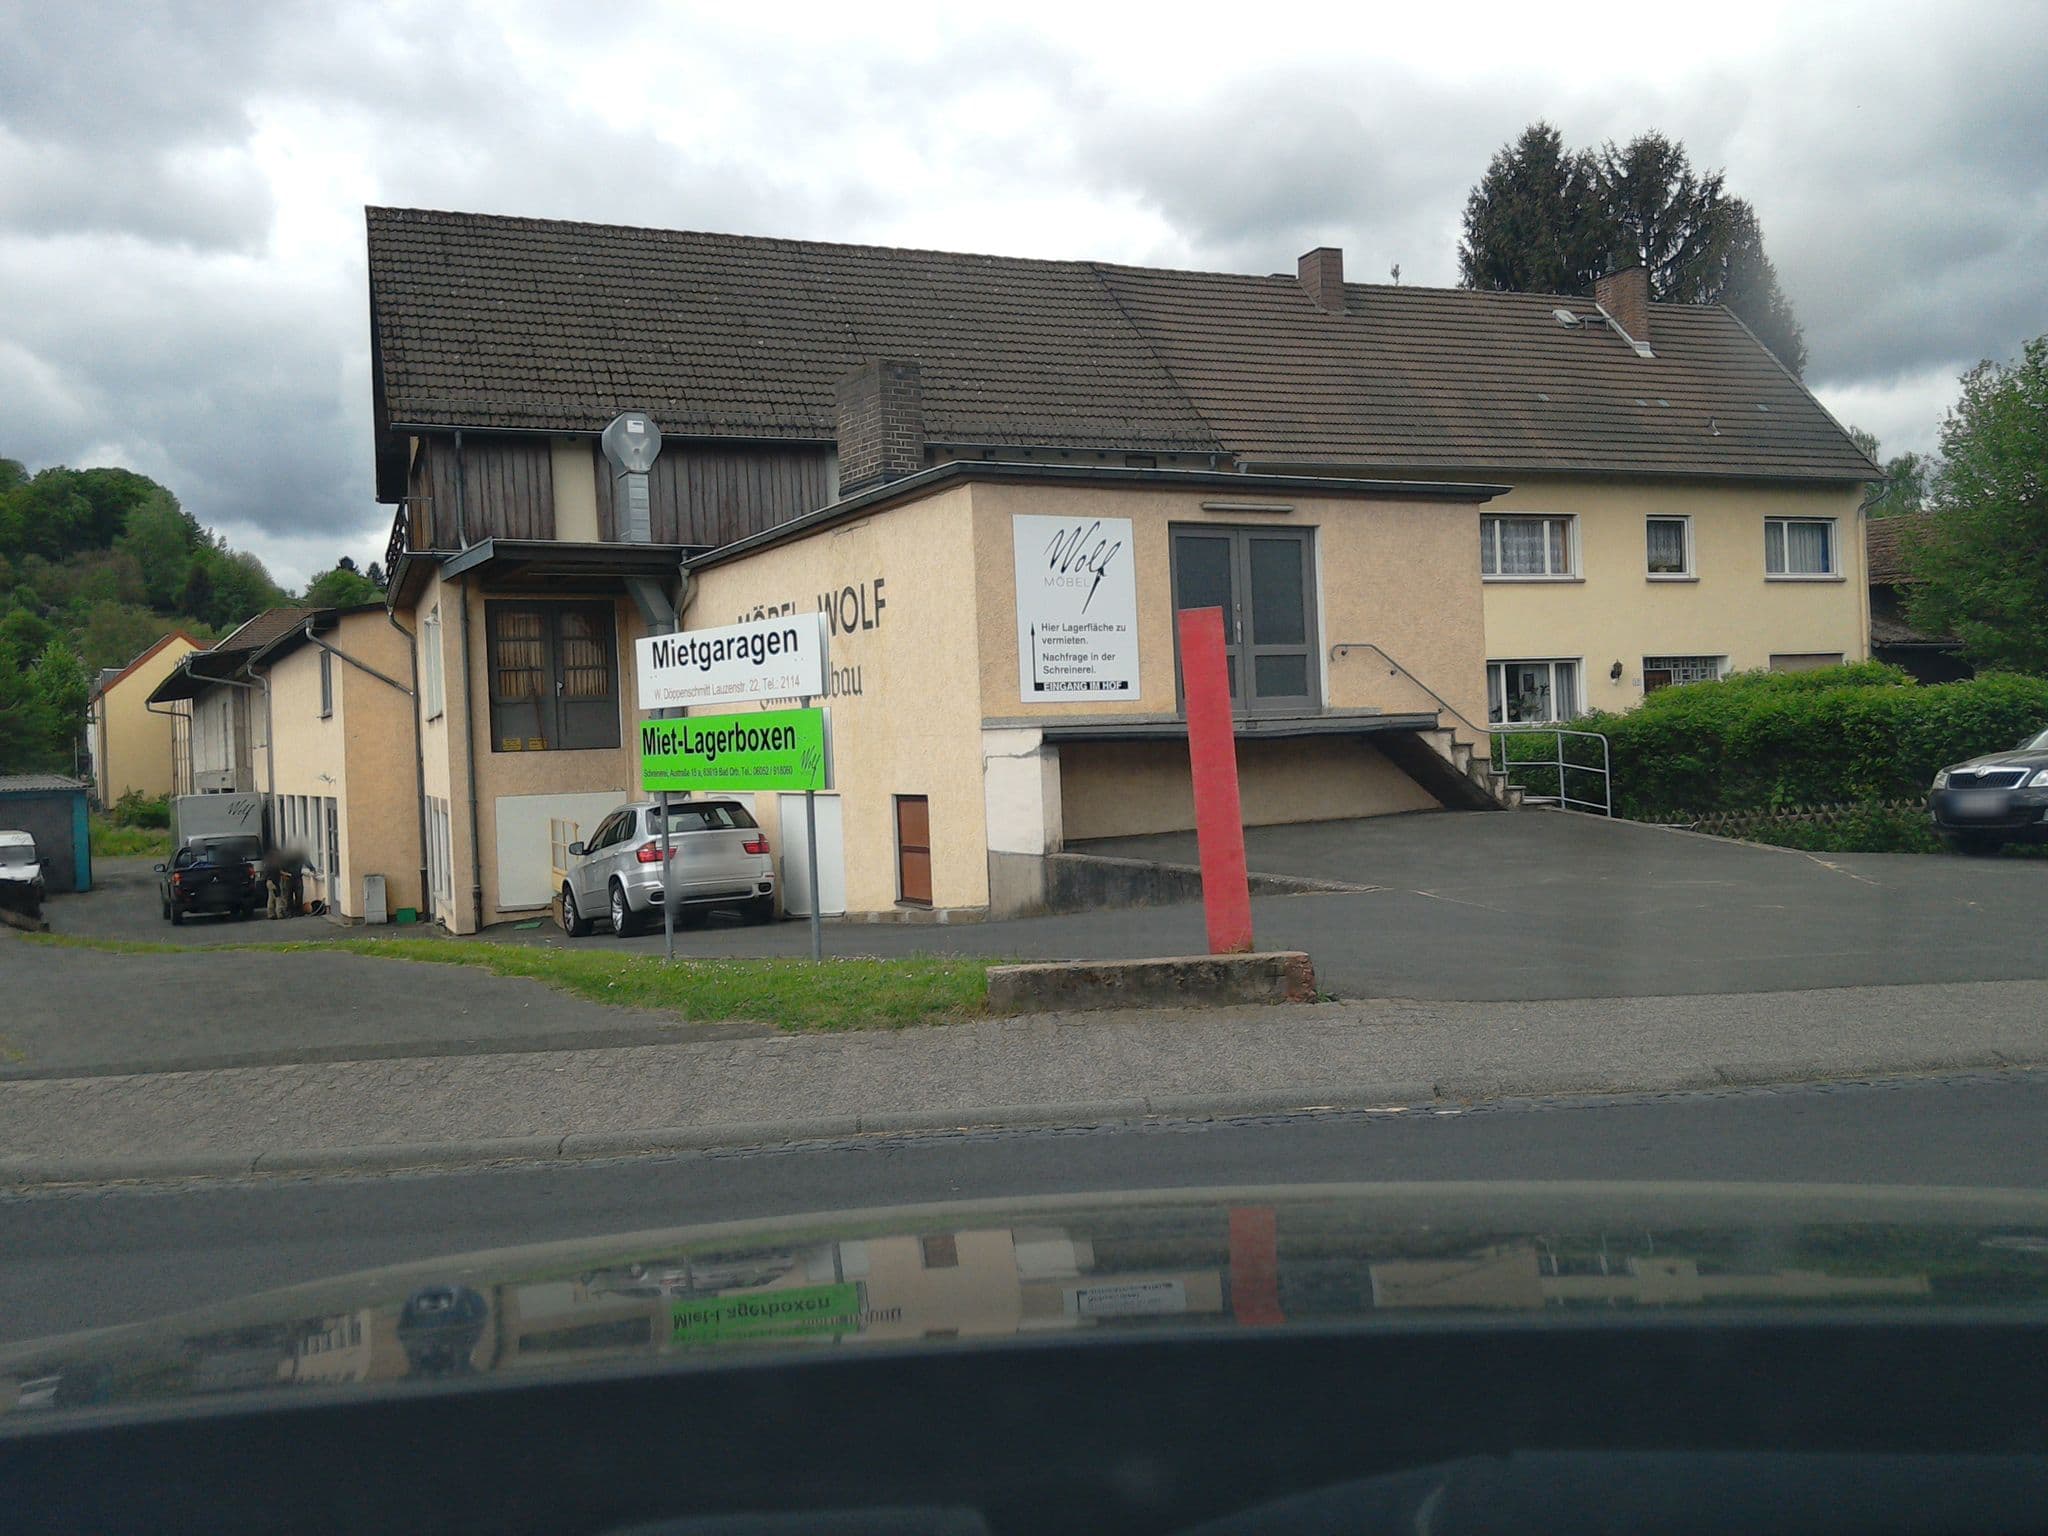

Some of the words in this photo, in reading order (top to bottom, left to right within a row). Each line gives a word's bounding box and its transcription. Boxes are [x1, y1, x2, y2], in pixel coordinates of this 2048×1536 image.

[1043, 520, 1121, 614] Wolf
[1044, 576, 1090, 588] MÖBEL
[817, 578, 886, 637] WOLF
[1041, 623, 1059, 632] Hier
[1062, 623, 1114, 634] Lagerfläche
[1116, 624, 1126, 632] zu
[1041, 636, 1089, 645] vermieten.
[652, 628, 798, 671] Mietgaragen
[1042, 652, 1088, 663] Nachfrage
[1091, 652, 1099, 661] in
[1101, 652, 1116, 661] der
[1043, 665, 1097, 675] Schreinerei.
[781, 675, 800, 689] 2114
[1044, 681, 1087, 691] EINGANG
[1091, 681, 1100, 691] IM
[1102, 681, 1123, 690] HOF
[643, 722, 795, 761] Miet-Lagerboxen
